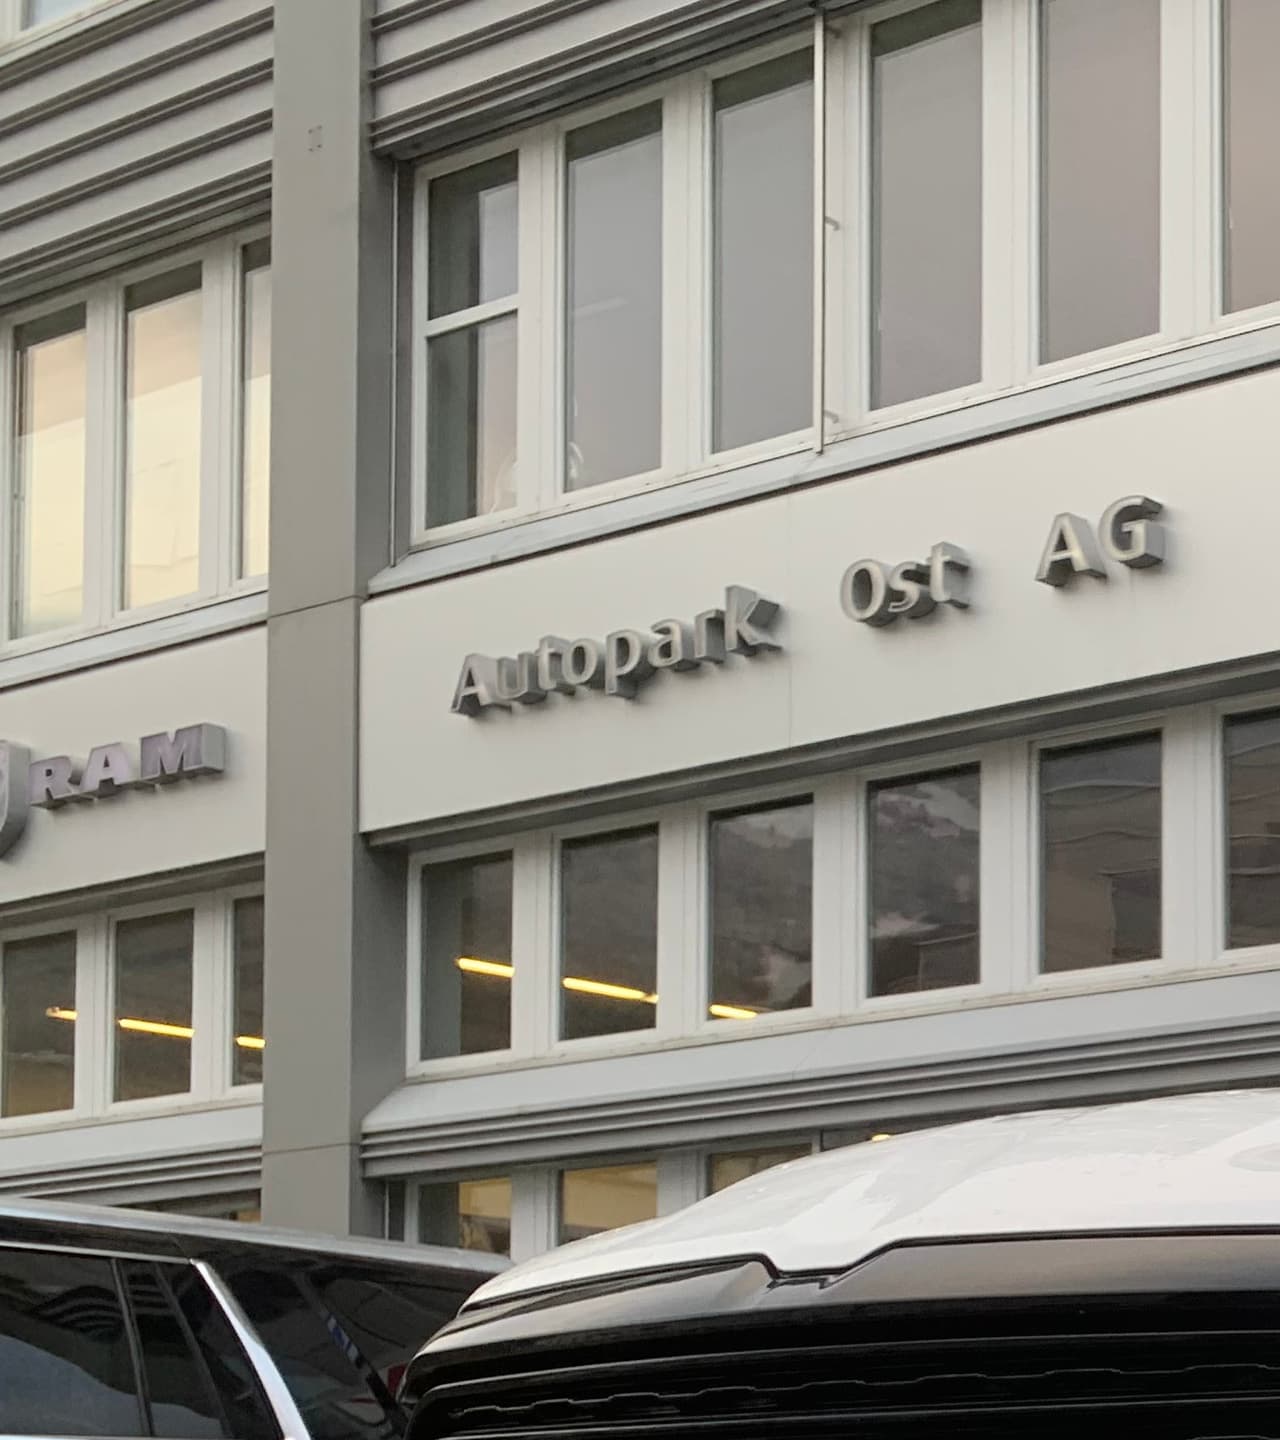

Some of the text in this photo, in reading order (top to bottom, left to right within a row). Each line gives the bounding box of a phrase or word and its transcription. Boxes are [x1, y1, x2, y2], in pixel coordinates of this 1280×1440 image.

[450, 494, 1166, 718] Autopark Ost AG
[29, 722, 226, 808] RAM
